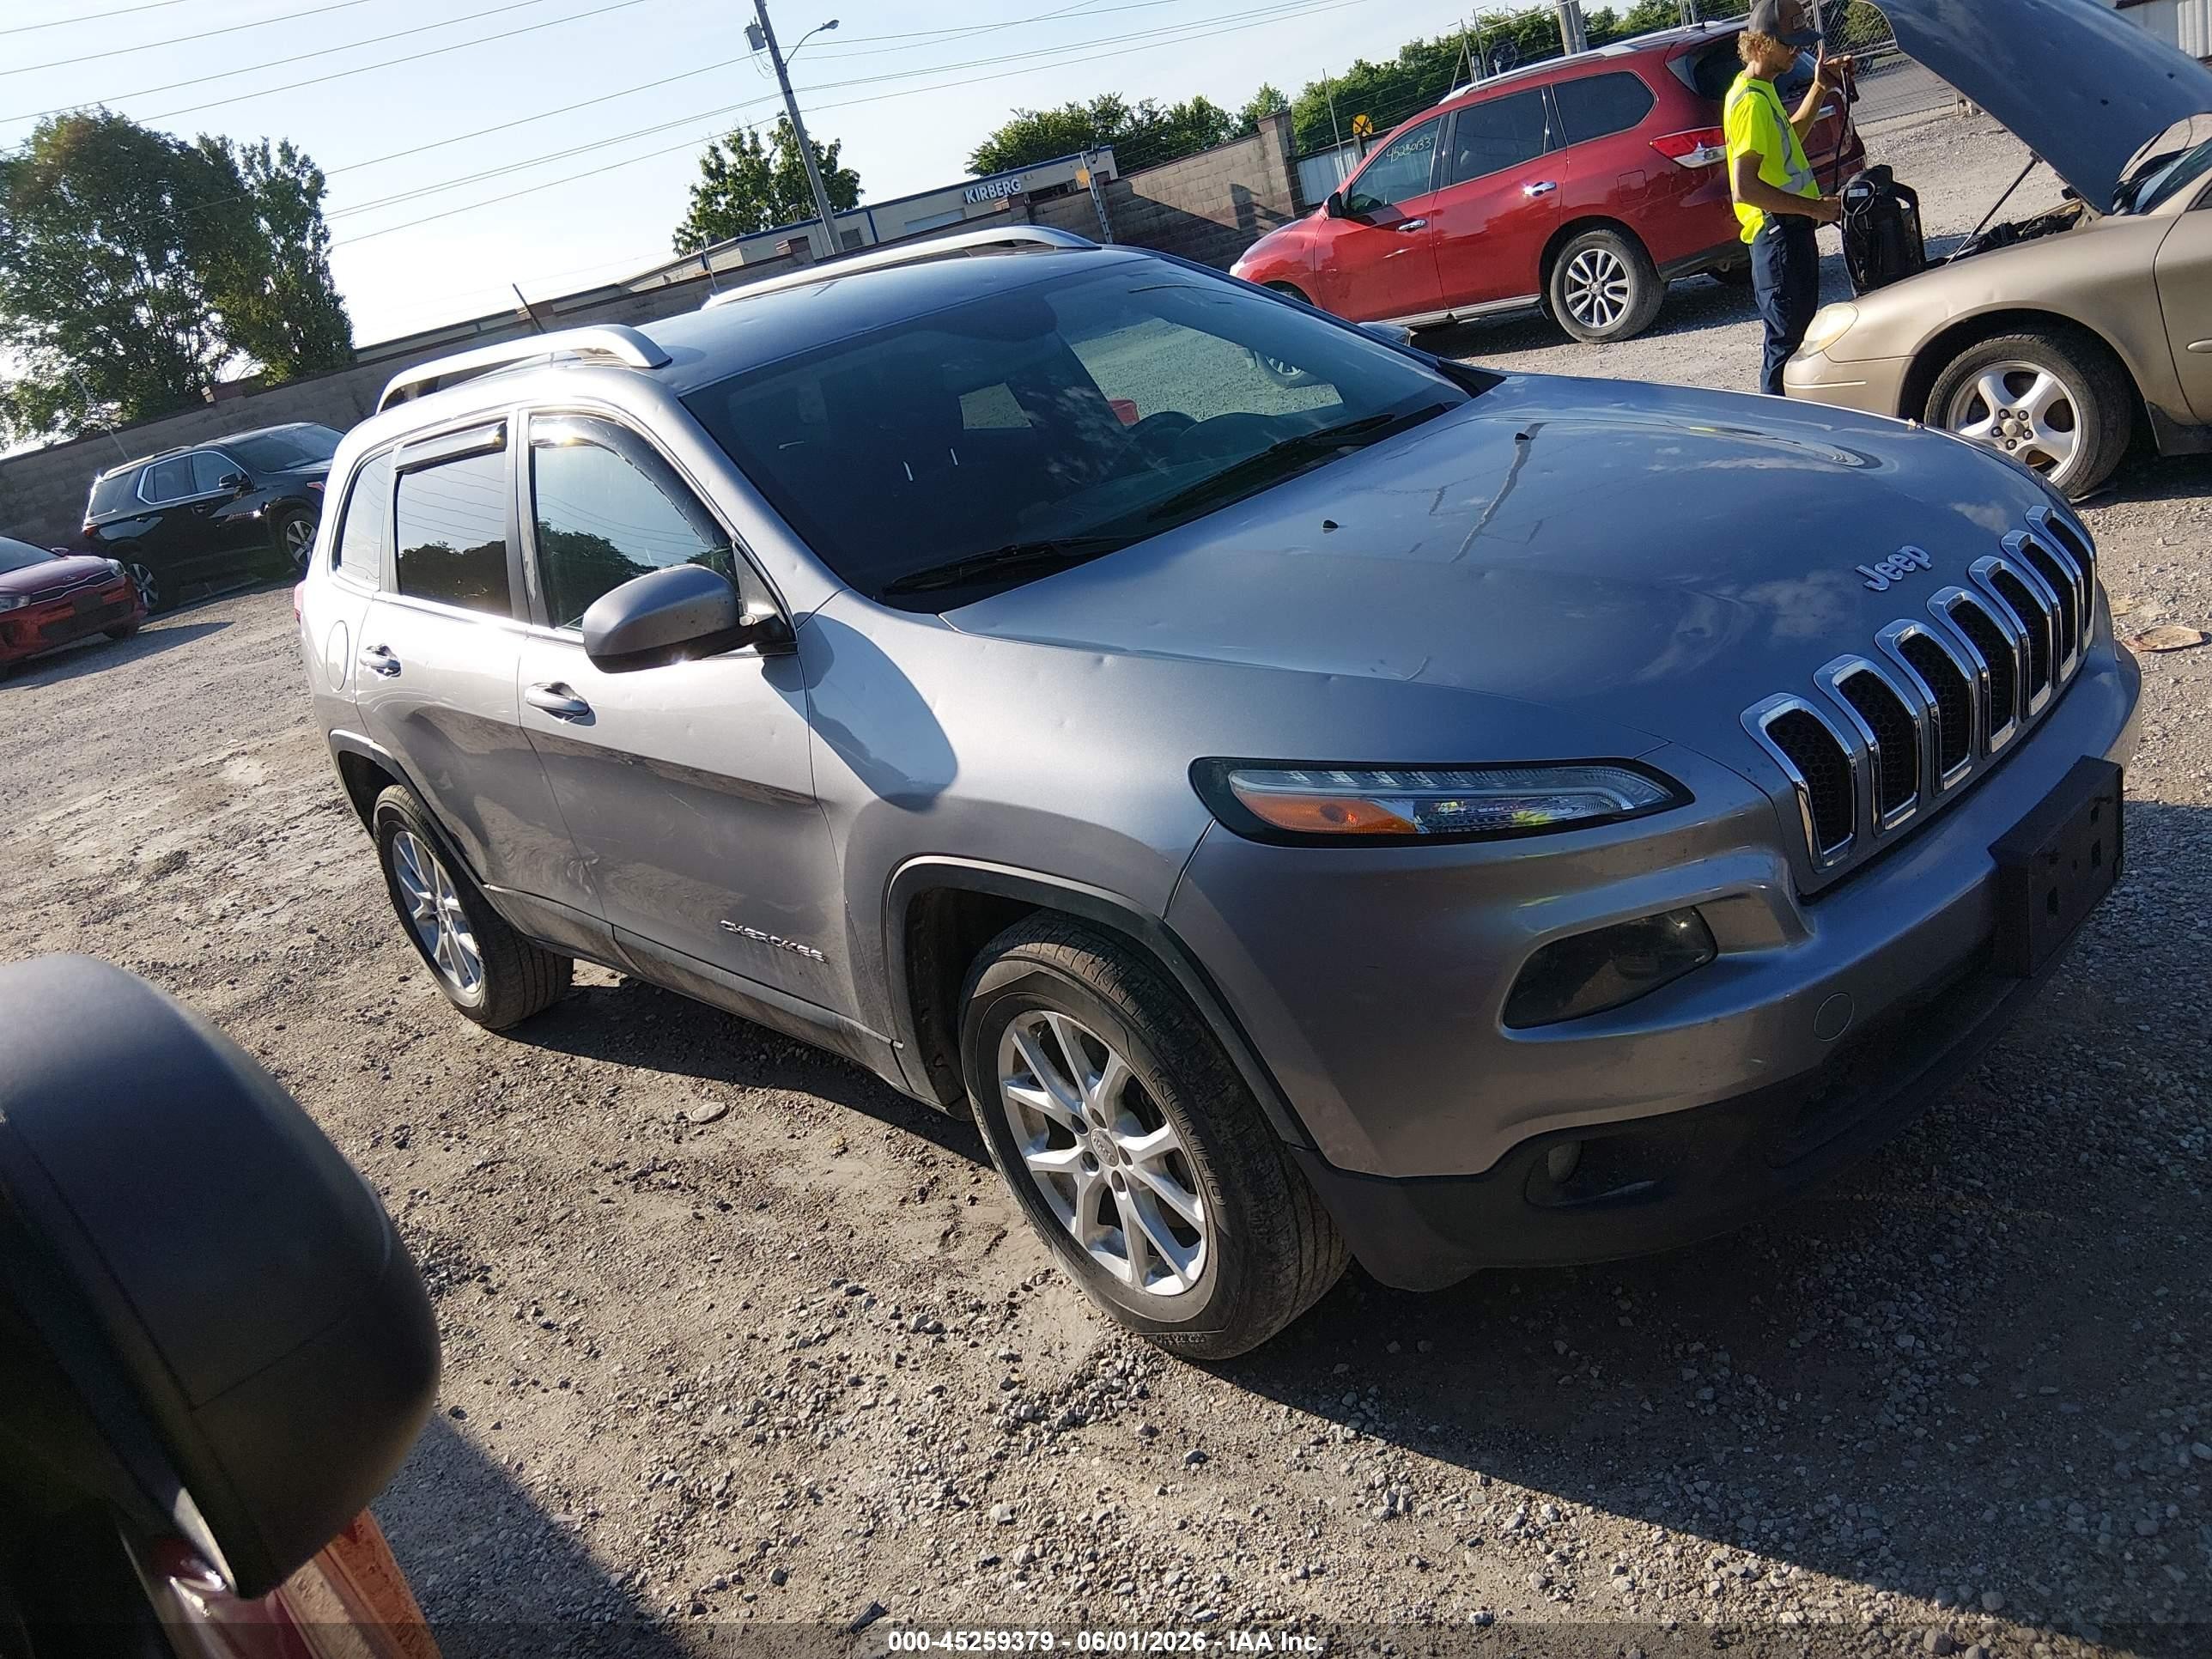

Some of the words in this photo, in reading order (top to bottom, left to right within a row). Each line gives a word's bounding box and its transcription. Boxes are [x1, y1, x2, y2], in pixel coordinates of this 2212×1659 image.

[963, 178, 1022, 204] KIRBERG
[1855, 545, 1932, 591] Jeep
[1147, 1065, 1226, 1206] KUMHO
